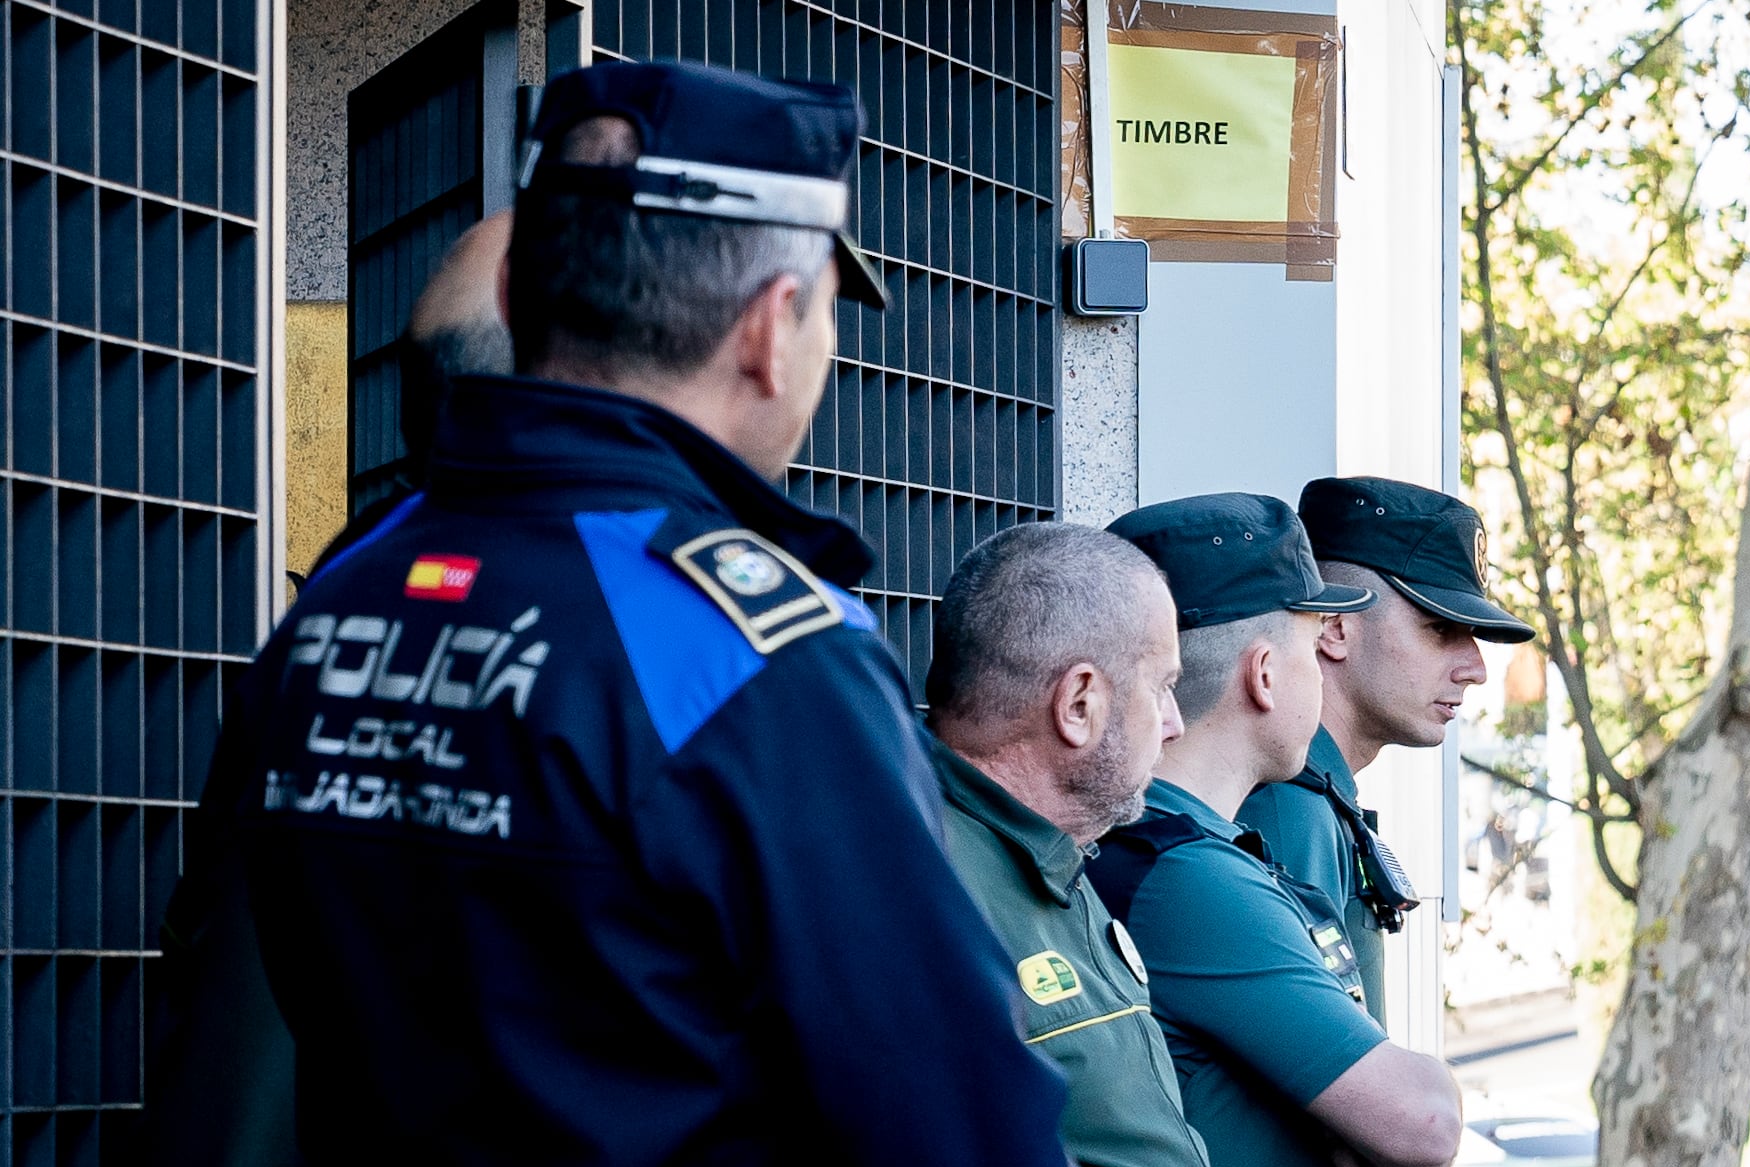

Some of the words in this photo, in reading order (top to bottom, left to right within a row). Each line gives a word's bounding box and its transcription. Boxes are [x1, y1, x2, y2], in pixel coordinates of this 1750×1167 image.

[1117, 119, 1228, 145] TIMBRE
[287, 605, 550, 718] POLICÍA
[306, 714, 466, 769] LOCAL
